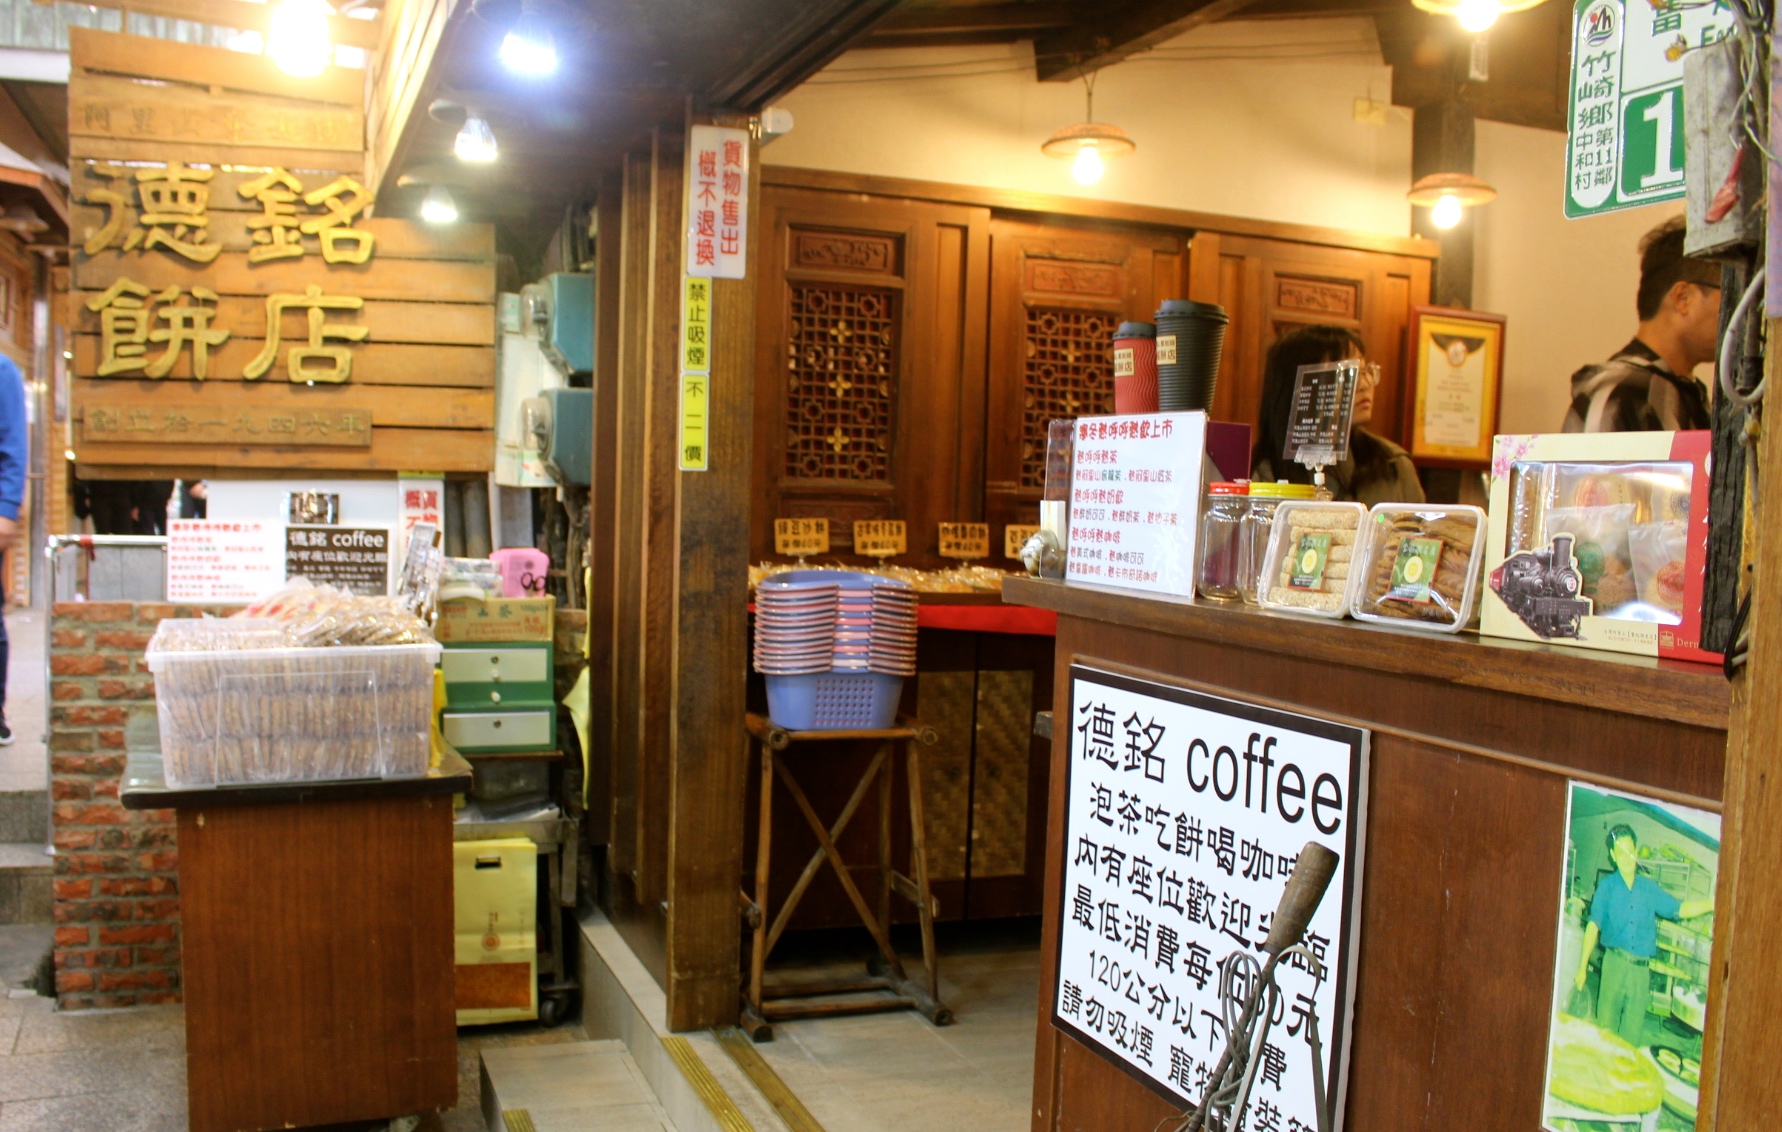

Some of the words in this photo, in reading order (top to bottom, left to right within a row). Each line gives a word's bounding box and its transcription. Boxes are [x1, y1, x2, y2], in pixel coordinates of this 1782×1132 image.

[1577, 50, 1616, 131] 竹崎鄉
[695, 150, 718, 266] 概不退換
[720, 139, 742, 255] 貨物售出
[1575, 133, 1593, 191] 中和村
[84, 161, 374, 265] 德銘
[87, 277, 370, 384] 餅店
[686, 283, 706, 366] 禁止吸煙
[684, 381, 703, 462] 不二價
[332, 530, 385, 548] coffee
[1077, 700, 1166, 785] 德銘
[1186, 732, 1343, 836] coffee
[1061, 979, 1154, 1068] 請勿吸煙
[1089, 949, 1288, 1092] 120公分以下費
